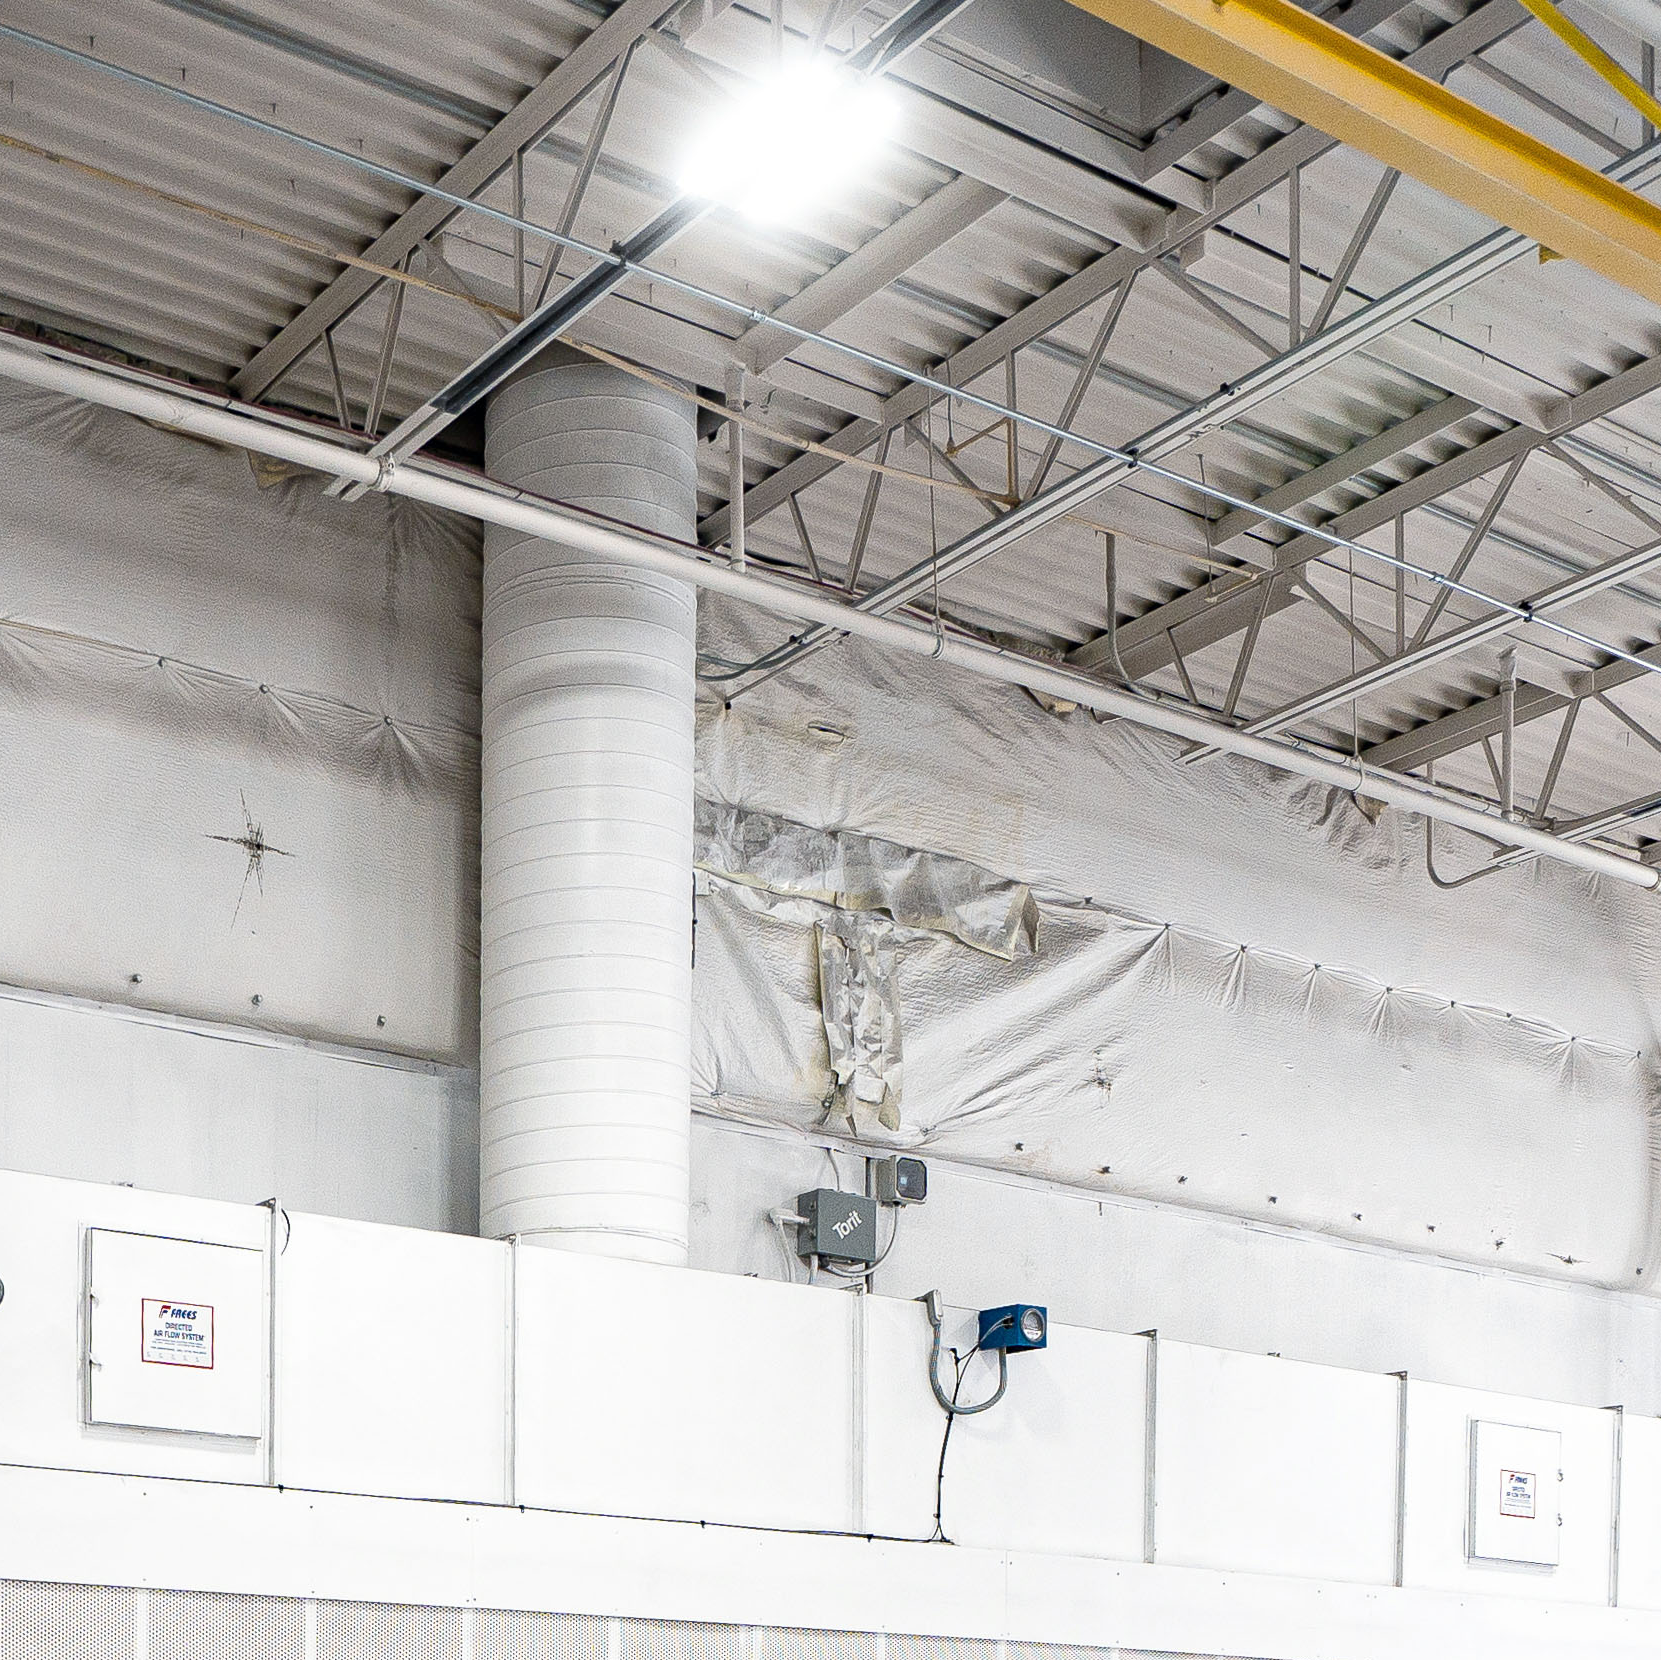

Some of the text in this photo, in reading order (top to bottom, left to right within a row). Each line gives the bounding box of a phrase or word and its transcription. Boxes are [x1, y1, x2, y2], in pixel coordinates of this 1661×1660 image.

[832, 1210, 862, 1239] Torit
[165, 1322, 192, 1331] DIRECTED
[165, 1331, 180, 1339] FLOW
[182, 1333, 204, 1341] SYSTEM
